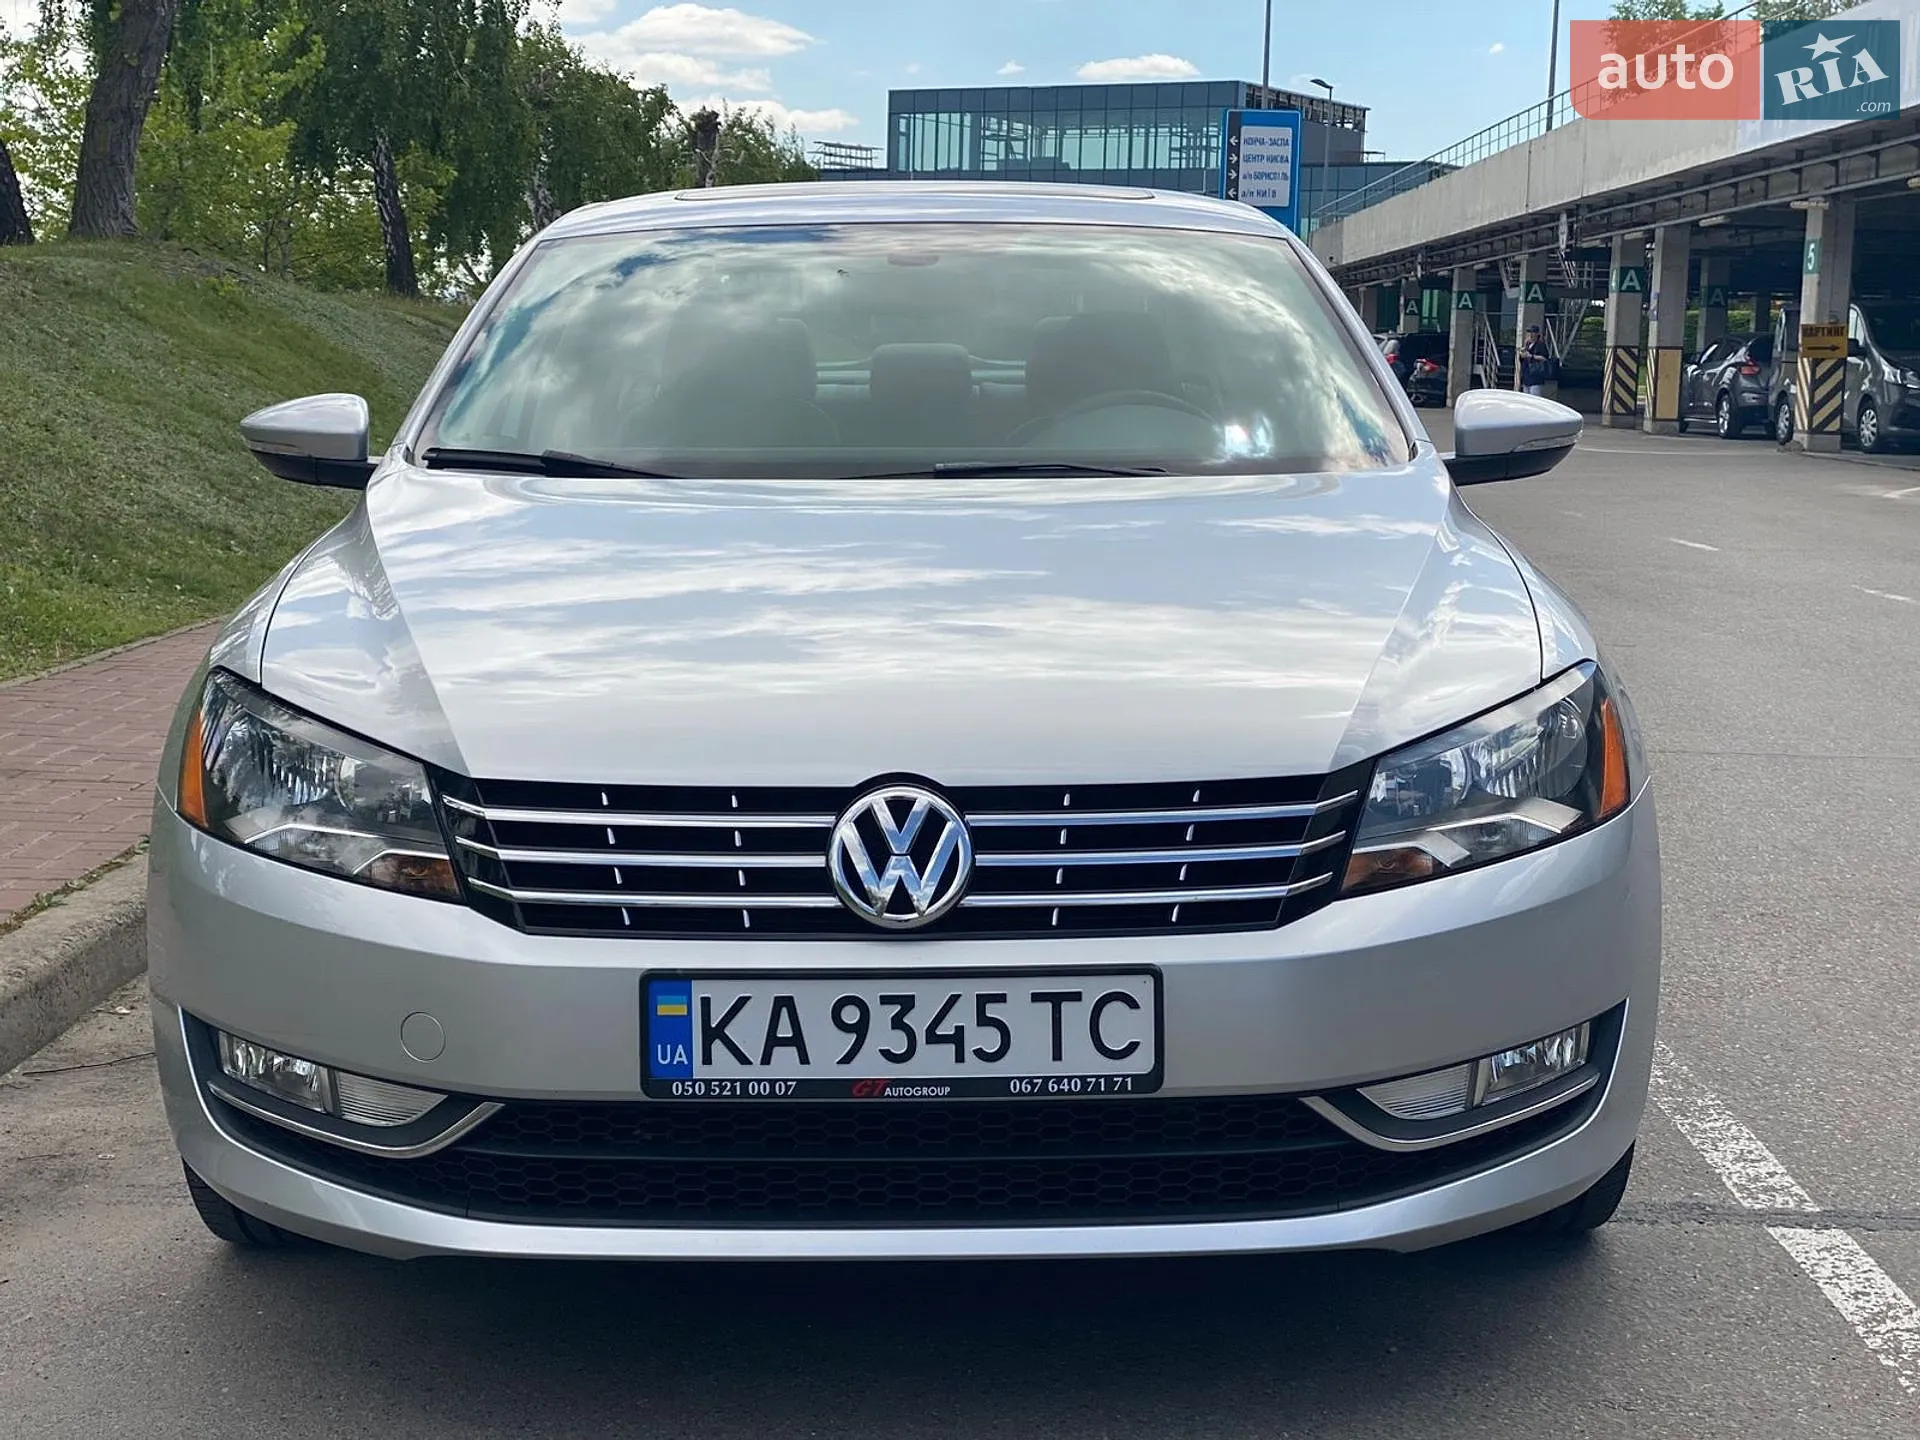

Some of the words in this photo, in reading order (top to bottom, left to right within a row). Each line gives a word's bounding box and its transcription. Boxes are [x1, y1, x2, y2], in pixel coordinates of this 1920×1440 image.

[1243, 154, 1265, 163] ЦЕНТР
[1807, 243, 1815, 270] 5
[700, 994, 811, 1066] KA
[830, 992, 1012, 1065] 9345
[1030, 990, 1141, 1062] TC
[657, 1044, 688, 1065] UA
[672, 1081, 705, 1096] 050
[710, 1081, 741, 1096] 521
[748, 1081, 770, 1096] 00
[775, 1081, 797, 1096] 07
[884, 1086, 950, 1097] AUTOGROUP
[1010, 1078, 1041, 1094] 067
[1048, 1078, 1080, 1093] 640
[1086, 1077, 1106, 1092] 71
[1113, 1076, 1132, 1092] 71
